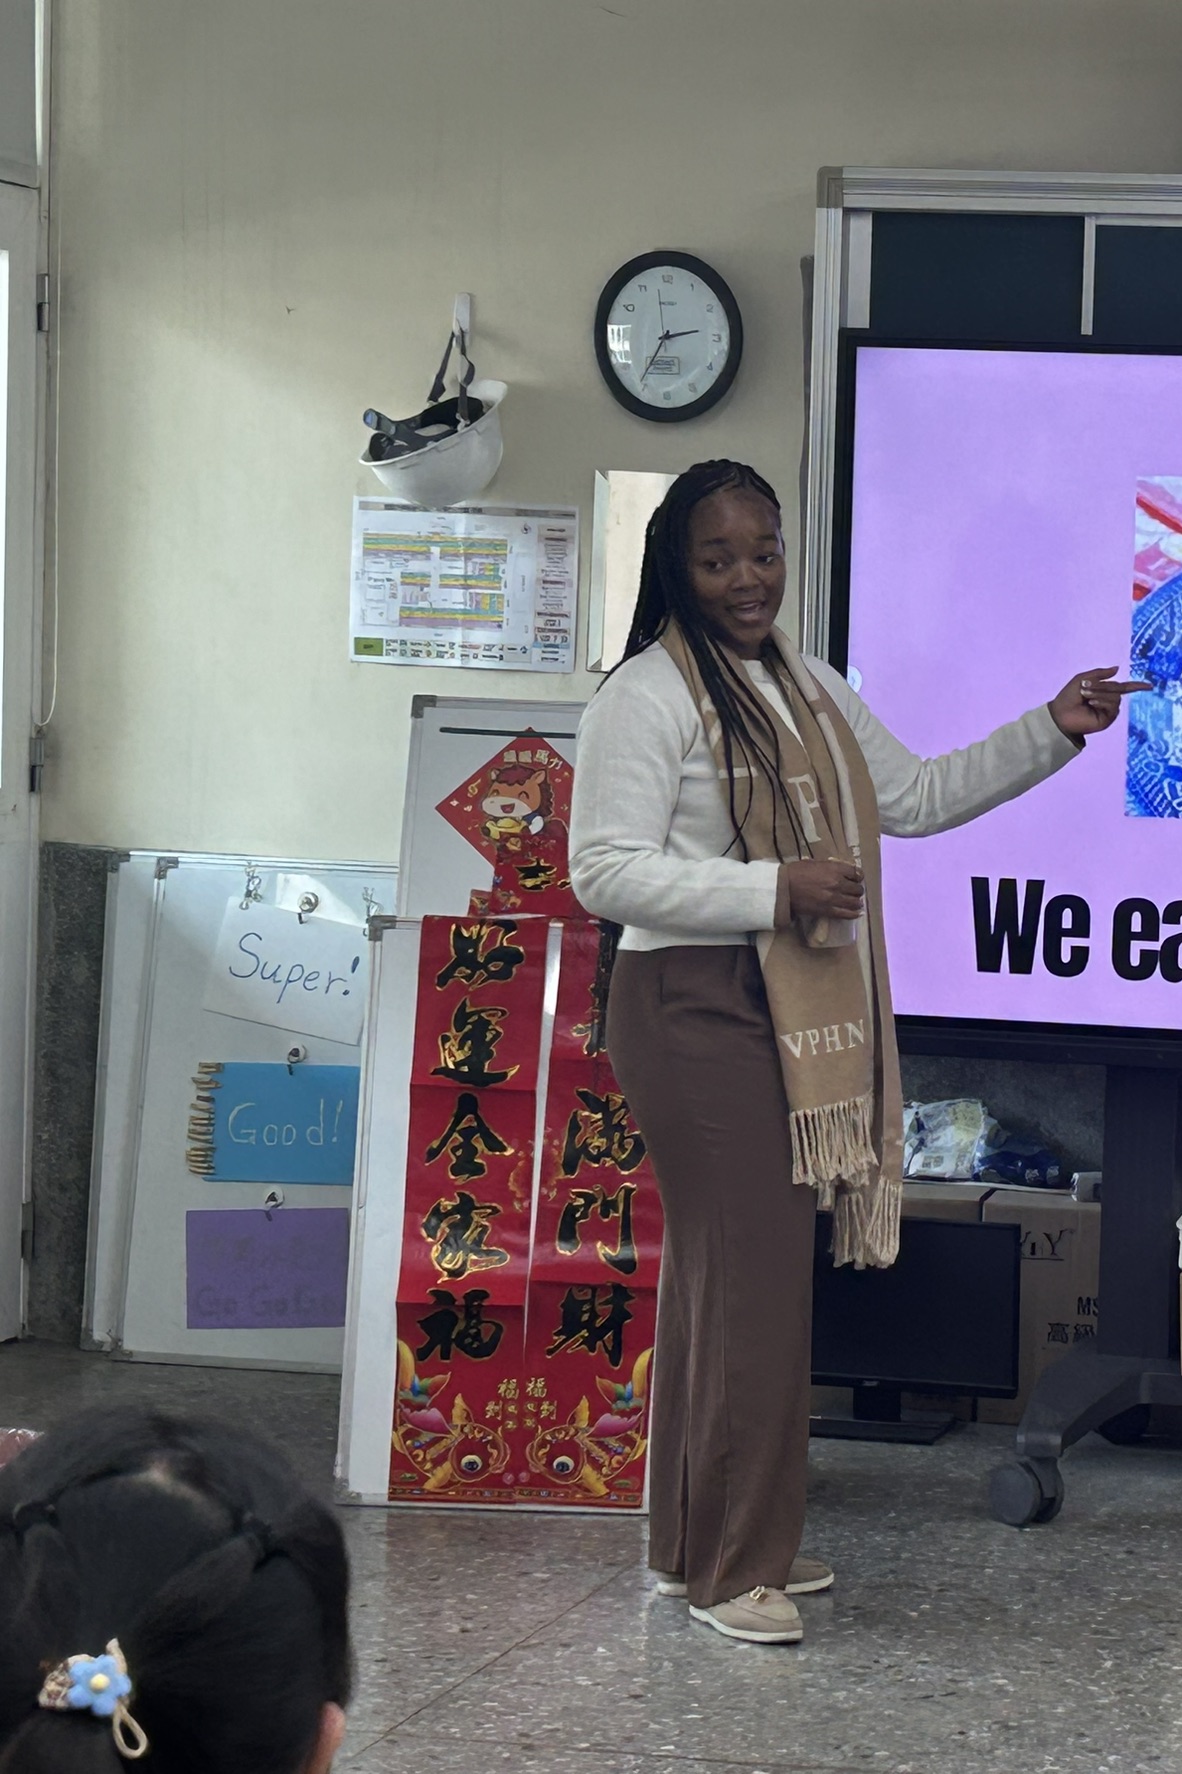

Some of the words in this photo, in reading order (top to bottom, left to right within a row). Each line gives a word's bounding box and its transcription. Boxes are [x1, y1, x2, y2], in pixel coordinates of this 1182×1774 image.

[970, 876, 1091, 978] We
[228, 932, 360, 1004] Super!
[778, 1017, 866, 1060] VPHN
[227, 1098, 344, 1146] Good!
